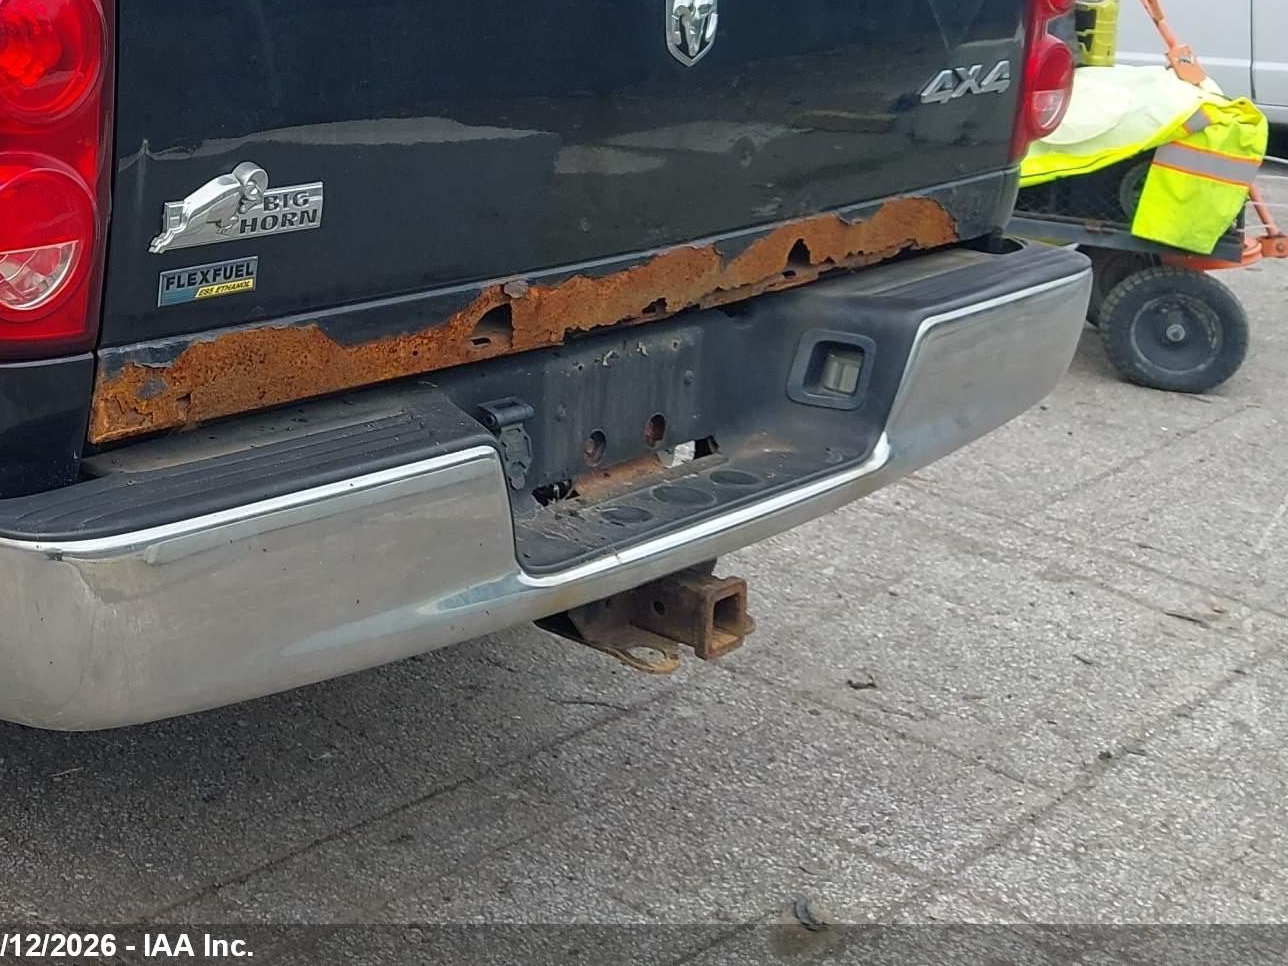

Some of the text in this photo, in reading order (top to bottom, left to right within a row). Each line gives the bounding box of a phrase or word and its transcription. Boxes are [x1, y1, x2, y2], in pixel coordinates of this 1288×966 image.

[263, 190, 310, 212] BIG
[239, 208, 318, 234] HORN
[165, 262, 254, 291] FLEXFUEL
[198, 280, 251, 296] E85 ETHANOL
